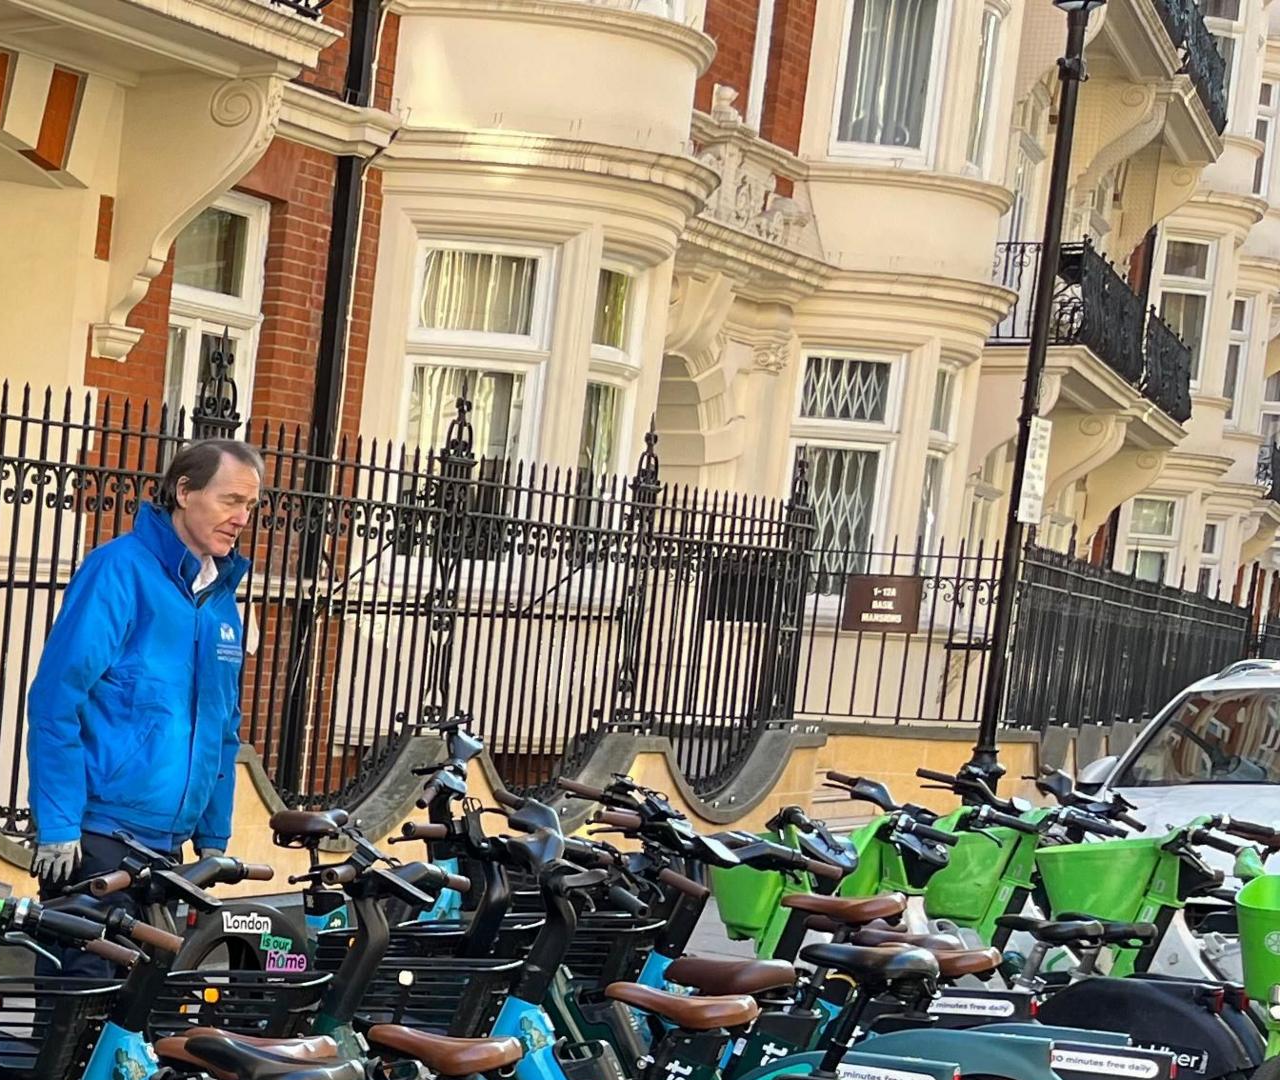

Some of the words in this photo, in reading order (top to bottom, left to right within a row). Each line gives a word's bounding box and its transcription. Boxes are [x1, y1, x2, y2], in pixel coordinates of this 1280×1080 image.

[225, 914, 269, 931] London
[273, 938, 290, 951] our
[268, 951, 305, 969] home
[1065, 1056, 1103, 1067] minutes
[1106, 1060, 1126, 1070] free
[1128, 1063, 1152, 1074] daily
